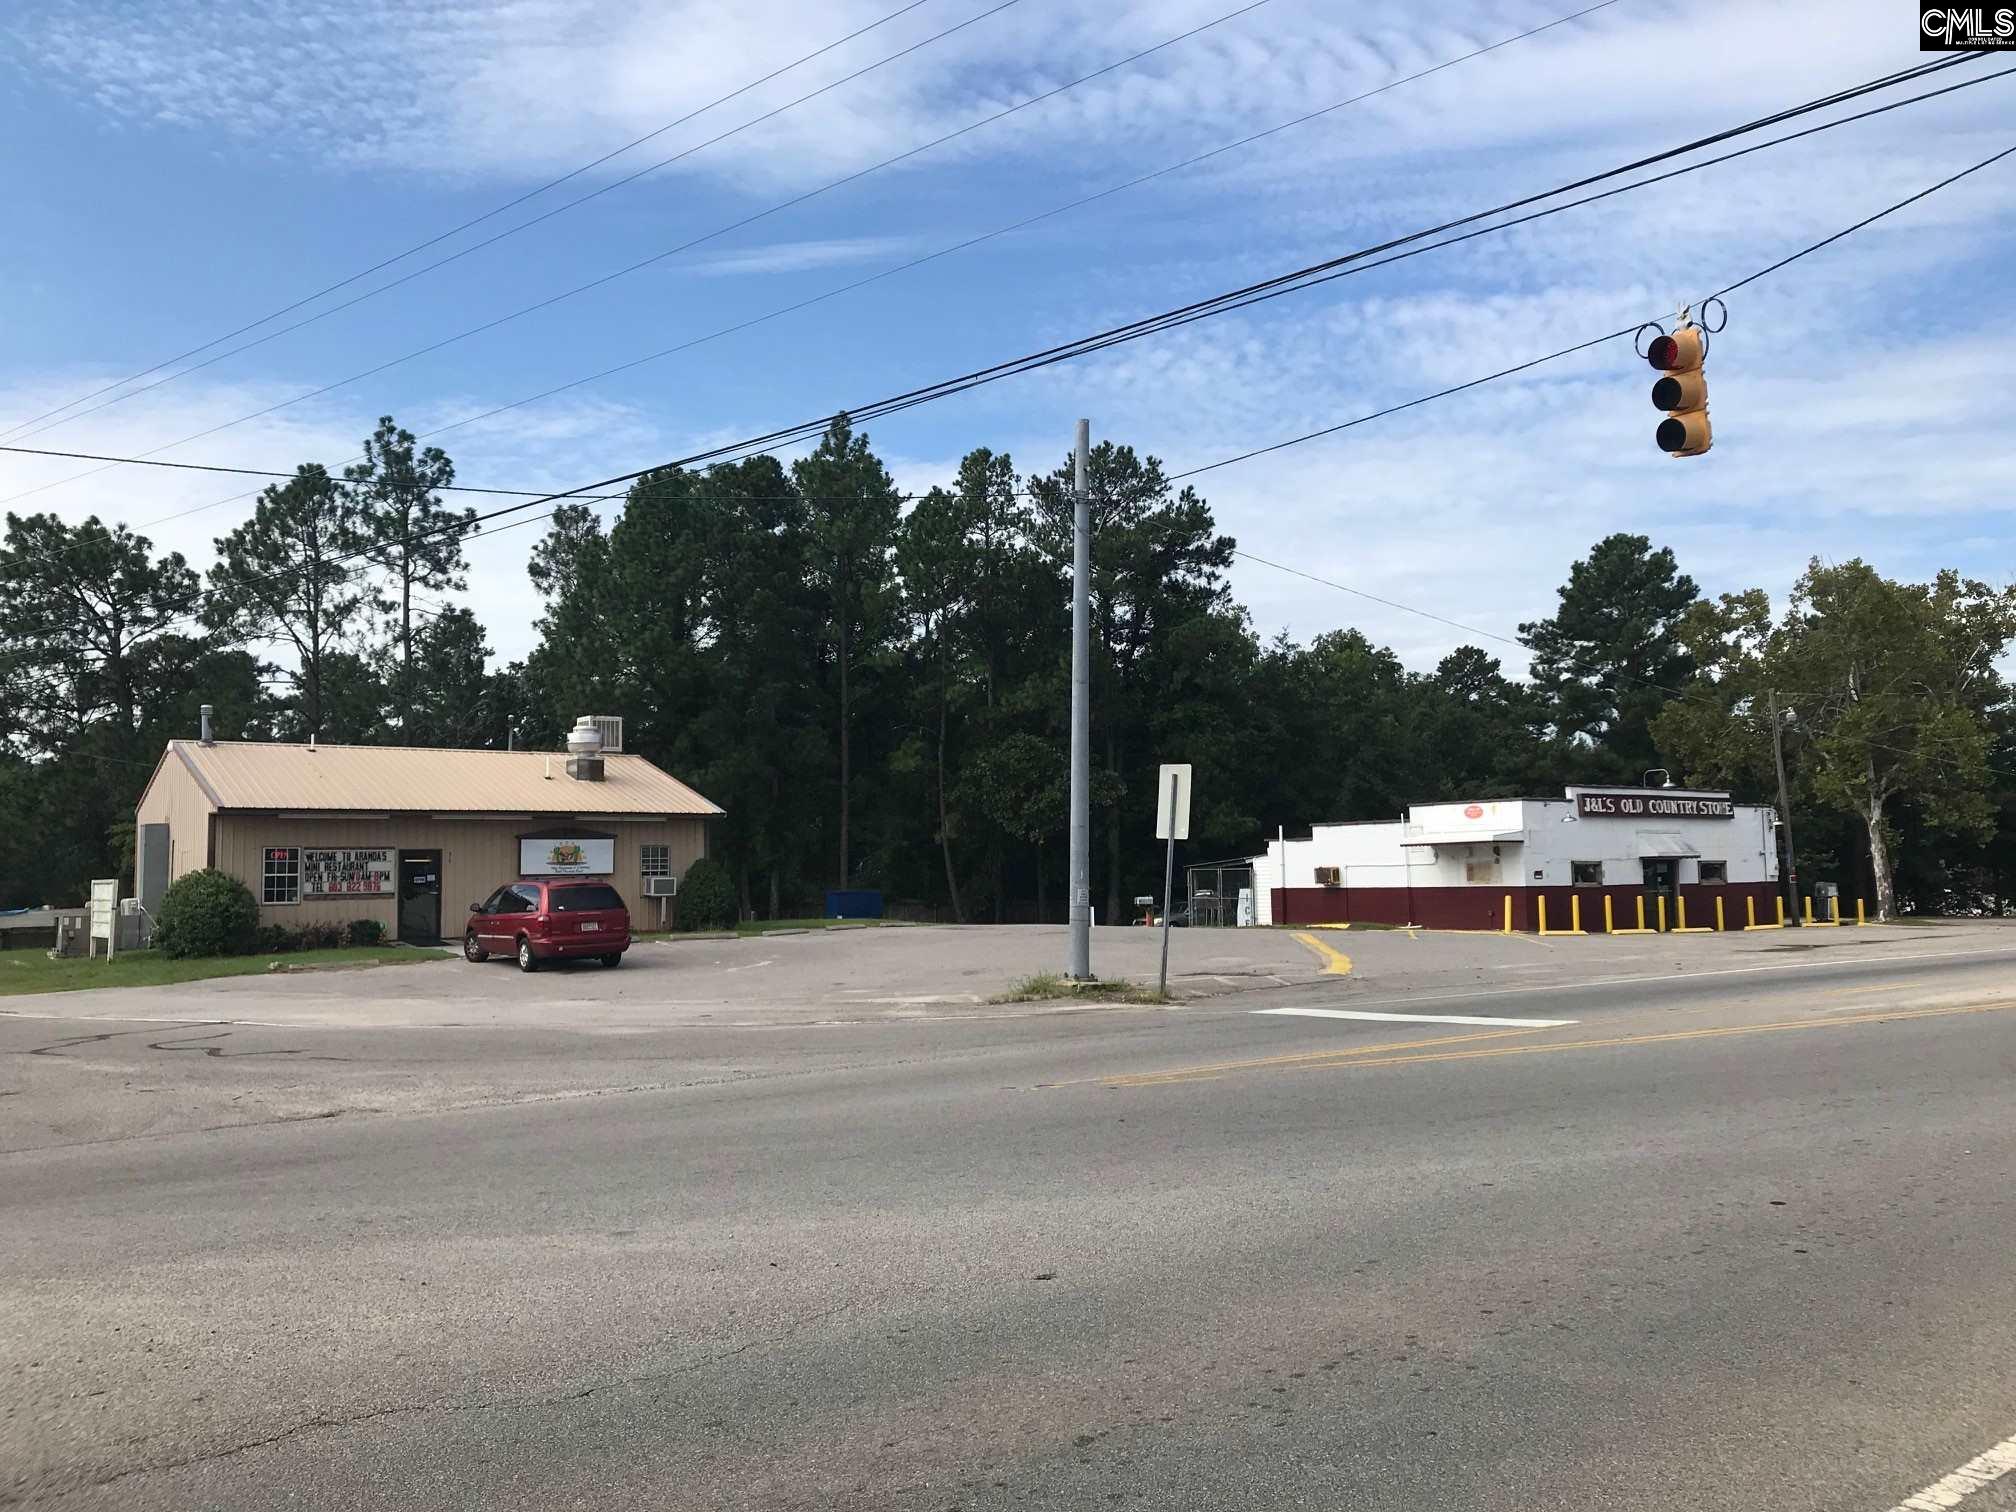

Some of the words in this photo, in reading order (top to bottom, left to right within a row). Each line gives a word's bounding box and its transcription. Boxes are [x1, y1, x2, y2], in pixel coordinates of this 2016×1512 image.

[1584, 797, 1615, 813] J&L'S
[1620, 799, 1644, 813] OLD
[1649, 799, 1698, 815] COUNTRY
[1700, 801, 1734, 815] STOE
[304, 851, 337, 861] WELCOME
[304, 871, 323, 881] OPEN
